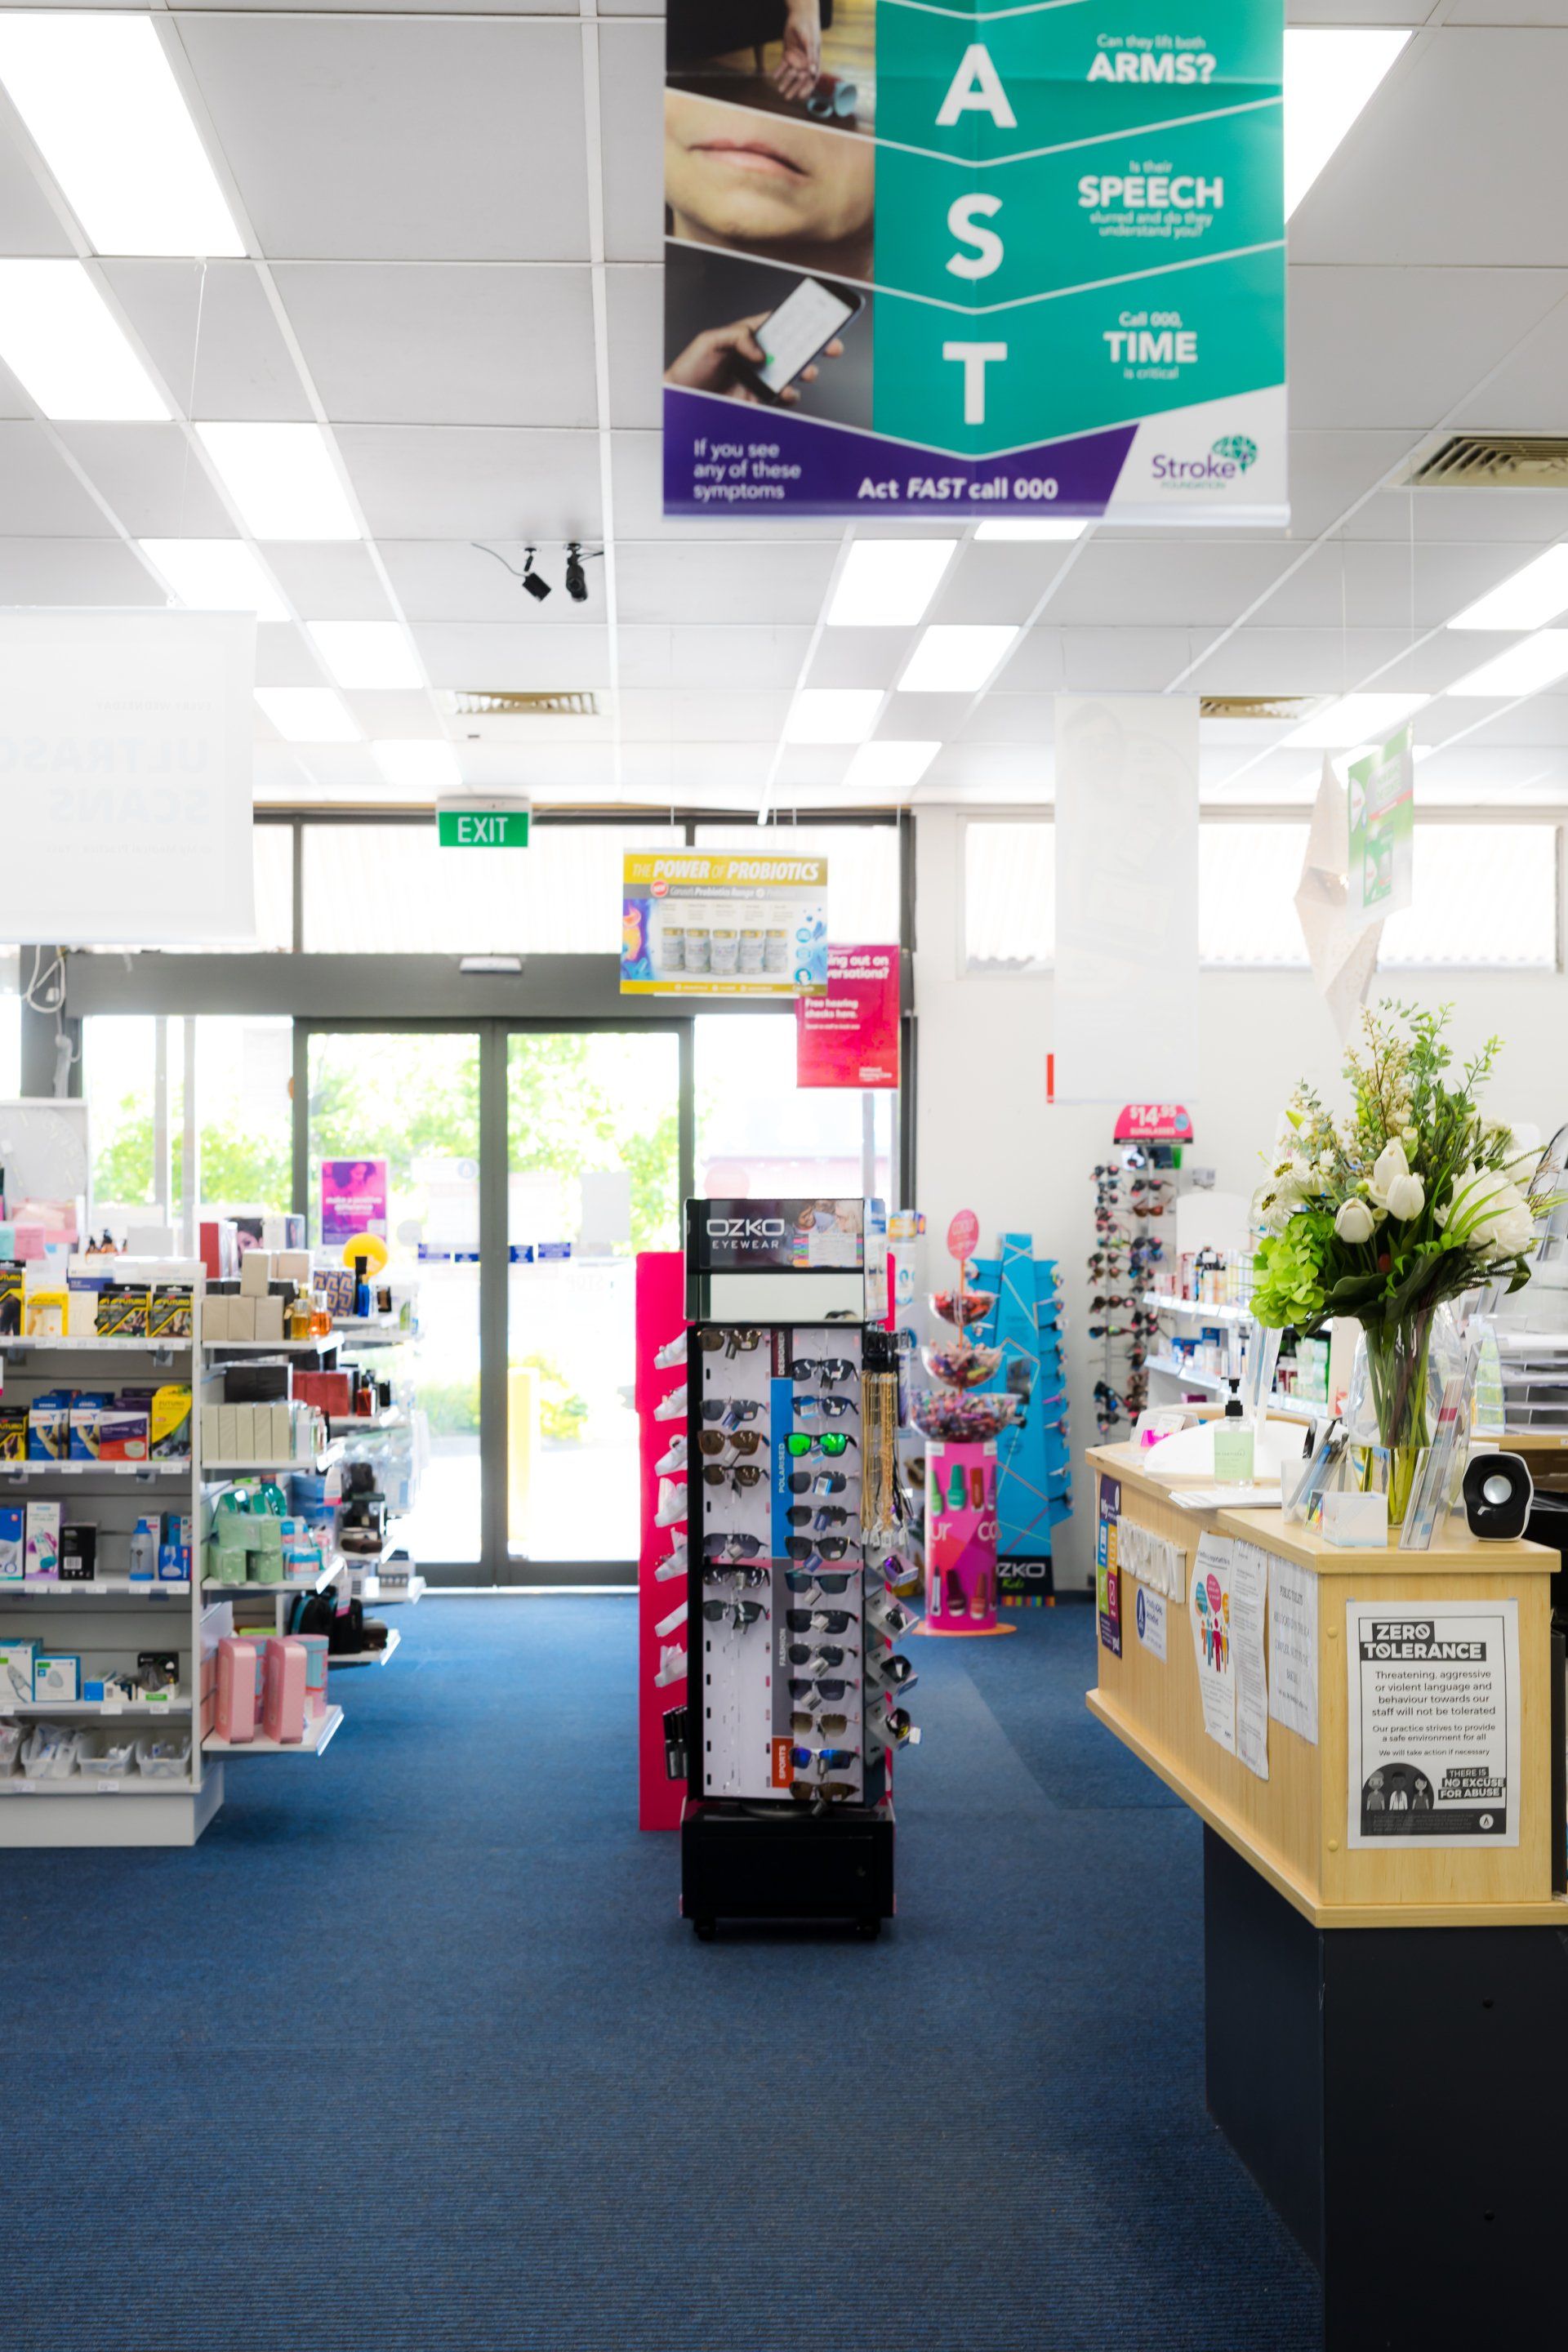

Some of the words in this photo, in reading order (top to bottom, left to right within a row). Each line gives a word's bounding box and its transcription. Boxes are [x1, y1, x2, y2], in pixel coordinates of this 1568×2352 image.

[1096, 33, 1123, 48] Can
[1086, 51, 1217, 84] ARMS?
[935, 43, 1018, 128] A
[1078, 175, 1224, 209] SPEECH
[1089, 210, 1134, 224] slurred
[1136, 210, 1161, 224] and
[1163, 210, 1183, 225] do
[946, 193, 1004, 280] S
[1098, 224, 1172, 238] understand
[1119, 310, 1148, 327] Call
[1102, 331, 1198, 363] TIME
[1136, 365, 1179, 380] critical
[942, 341, 1008, 425] T
[694, 437, 707, 457] If
[710, 443, 744, 462] you
[747, 443, 781, 458] see
[693, 464, 726, 483] any
[728, 458, 749, 479] of
[752, 459, 802, 479] these
[1152, 453, 1236, 479] Stroke
[693, 483, 785, 503] symptoms
[858, 477, 899, 499] Act
[906, 477, 967, 500] FAST
[968, 477, 1009, 500] call
[1013, 478, 1058, 500] 000
[457, 817, 508, 842] EXIT
[653, 860, 710, 878] POWER
[711, 865, 726, 878] OF
[727, 861, 819, 880] PROBIOTICS
[849, 955, 870, 966] out
[872, 956, 889, 966] on
[706, 1218, 785, 1236] OZKO
[712, 1240, 779, 1250] EYEWEAR
[997, 1562, 1045, 1578] ZKO
[1376, 1623, 1430, 1641] ZERO
[778, 1628, 786, 1667] FASHION
[1364, 1642, 1482, 1659] TOLERANCE
[1374, 1670, 1437, 1681] Threatening,
[1440, 1669, 1491, 1682] aggressive
[1388, 1682, 1421, 1691] violent
[1424, 1682, 1470, 1694] language
[1472, 1682, 1492, 1690] and
[1379, 1695, 1428, 1704] behaviour
[1430, 1695, 1470, 1704] towards
[1472, 1695, 1490, 1704] our
[1372, 1708, 1394, 1717] staff
[1396, 1708, 1414, 1716] will
[1416, 1708, 1432, 1716] not
[1436, 1707, 1449, 1715] be
[1451, 1705, 1496, 1715] tolerated
[1372, 1725, 1388, 1733] Our
[1390, 1725, 1424, 1734] practice
[1425, 1725, 1452, 1733] strives
[1464, 1724, 1496, 1733] provide
[1389, 1735, 1406, 1743] safe
[1407, 1733, 1462, 1742] environment
[1463, 1733, 1474, 1741] for
[1476, 1733, 1486, 1741] all
[1454, 1748, 1490, 1757] necessary
[778, 1744, 786, 1780] SPORTS
[1450, 1769, 1477, 1778] THERE
[1478, 1768, 1486, 1776] IS
[1444, 1778, 1461, 1788] NO
[1462, 1777, 1504, 1788] EXCUSE
[1440, 1788, 1462, 1798] FOR
[1463, 1788, 1500, 1797] ABUSE
